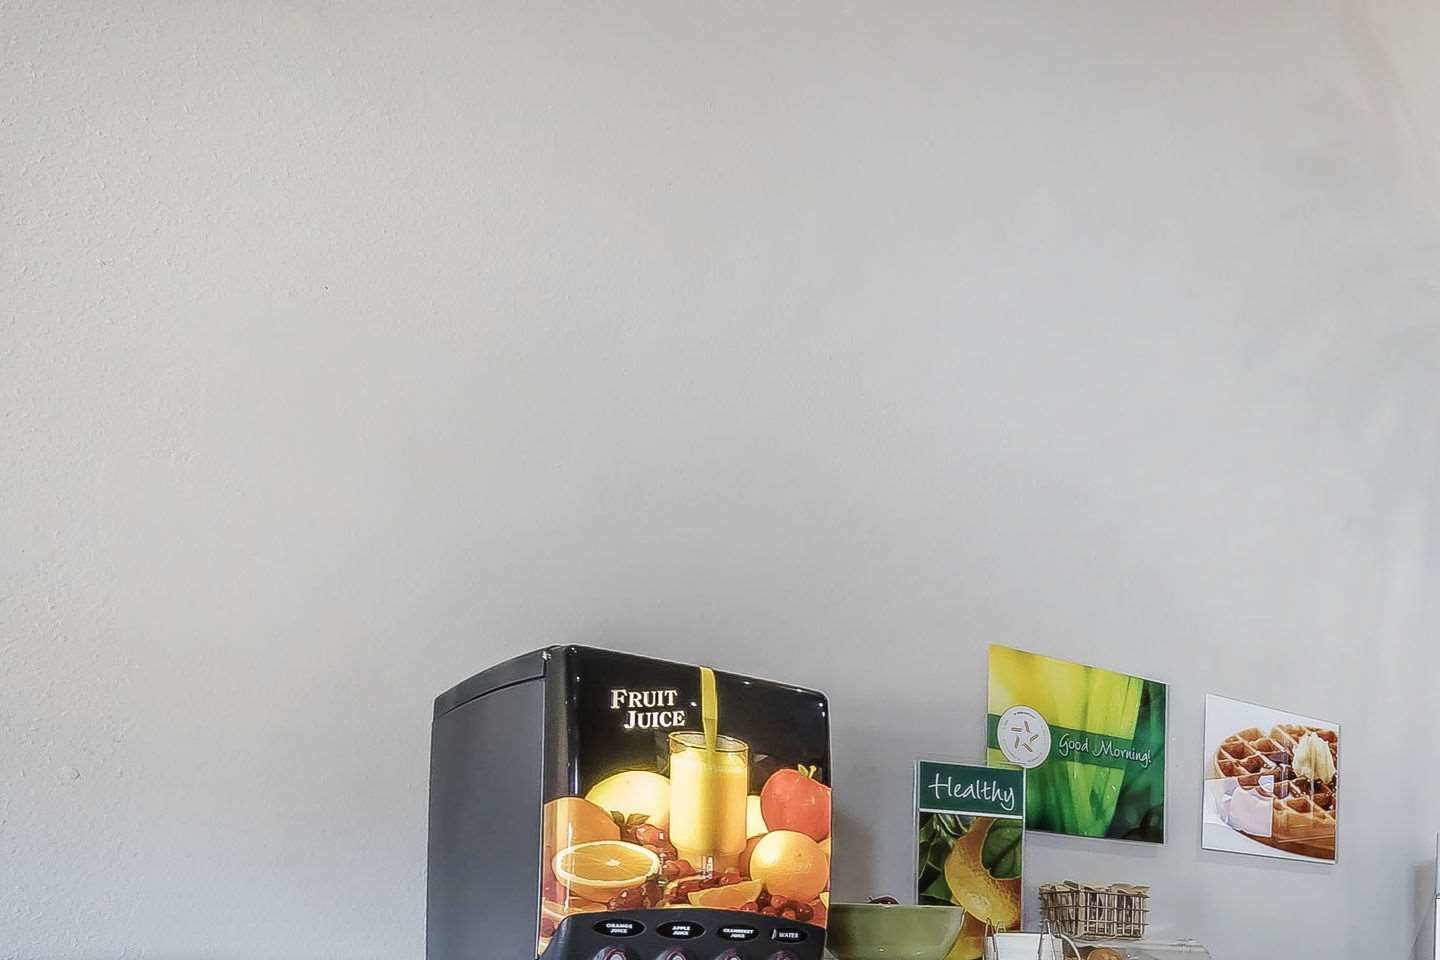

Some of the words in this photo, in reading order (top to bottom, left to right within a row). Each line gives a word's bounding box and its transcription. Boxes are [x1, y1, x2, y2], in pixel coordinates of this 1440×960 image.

[610, 689, 678, 709] FRUIT
[623, 710, 686, 729] JUICE
[1058, 733, 1089, 757] Good
[1093, 740, 1152, 768] Morning!
[927, 773, 1015, 811] Healthy
